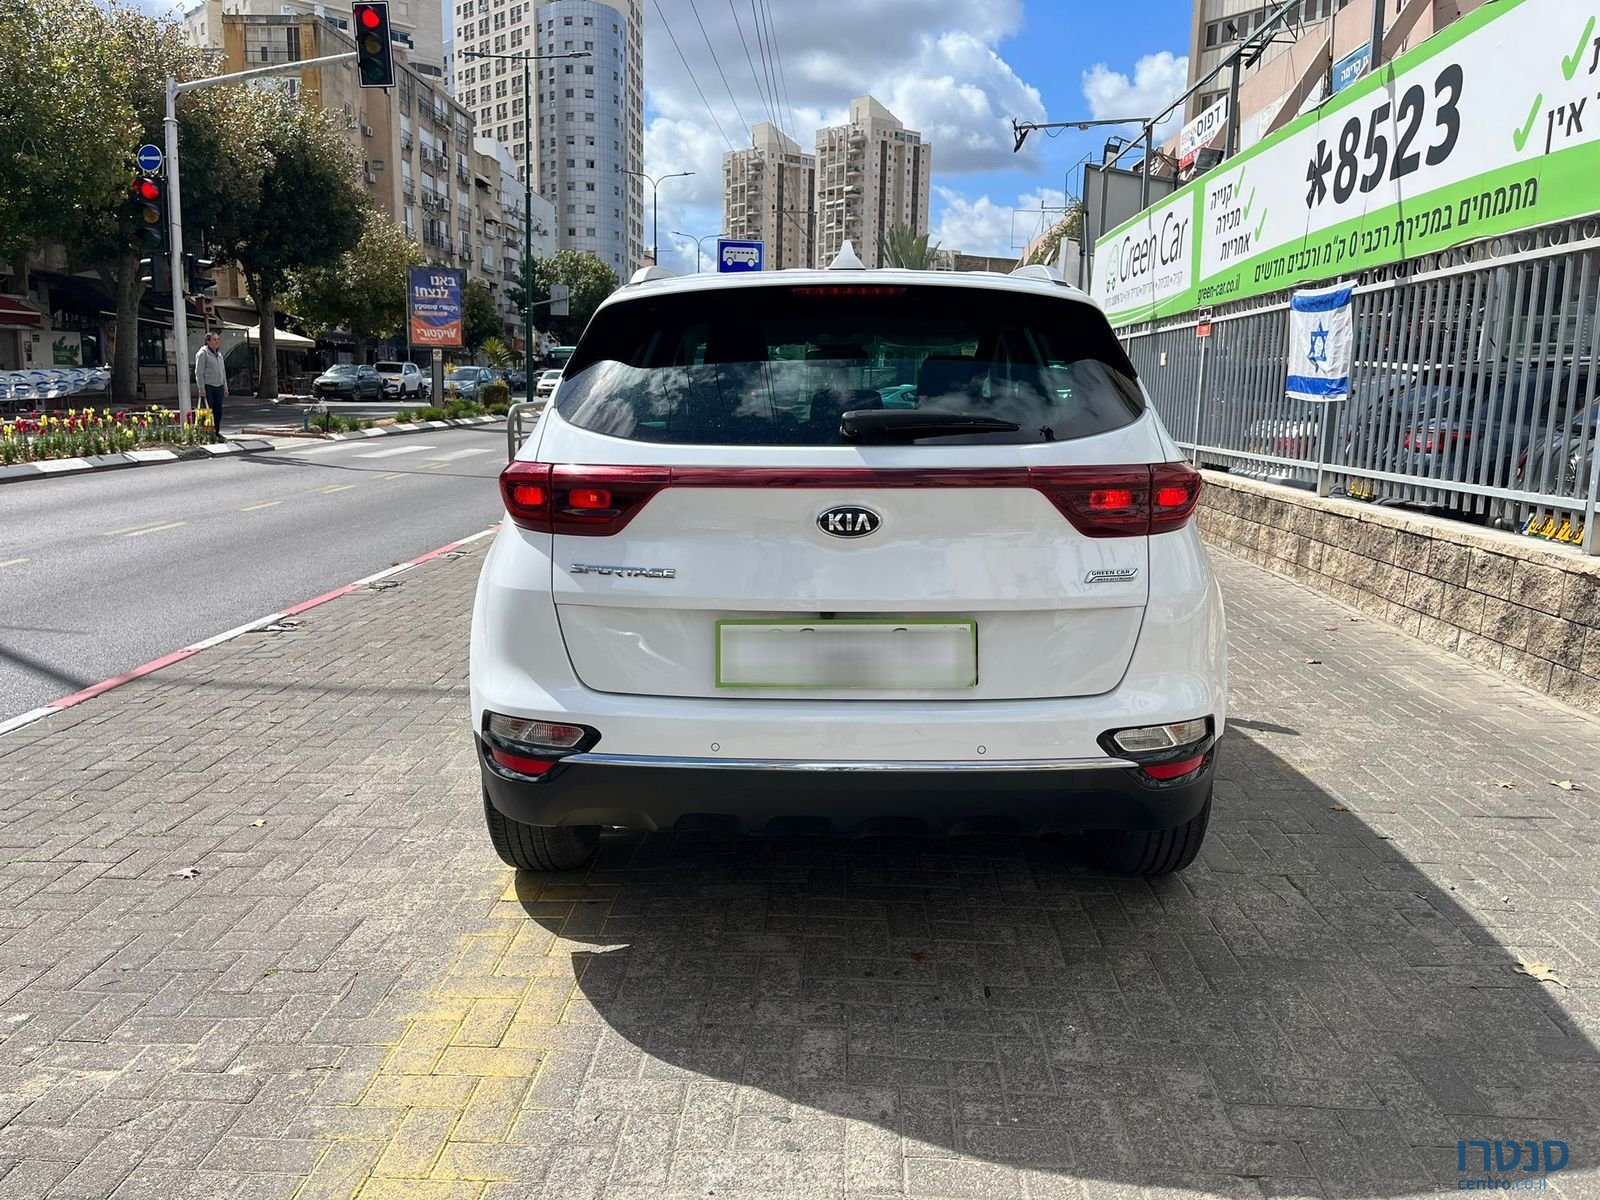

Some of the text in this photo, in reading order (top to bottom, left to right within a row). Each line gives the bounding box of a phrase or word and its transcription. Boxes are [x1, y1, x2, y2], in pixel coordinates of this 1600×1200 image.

[1197, 106, 1220, 136] דפוס
[1211, 183, 1233, 210] קנייה
[1458, 177, 1538, 226] מתמחים
[1215, 207, 1241, 235] מכירה
[1393, 204, 1452, 245] במכירת
[1120, 211, 1188, 283] Green Car
[1220, 231, 1251, 261] אחריות
[1349, 230, 1358, 258] 0
[1361, 225, 1390, 254] רכבי
[1254, 257, 1285, 283] חדשים
[1287, 245, 1321, 274] ורכבים
[415, 286, 449, 298] לנצח!
[430, 275, 456, 287] באנו
[1197, 272, 1241, 304] green-car.co.il
[827, 513, 871, 531] KIA
[570, 563, 676, 579] SPORTAGE
